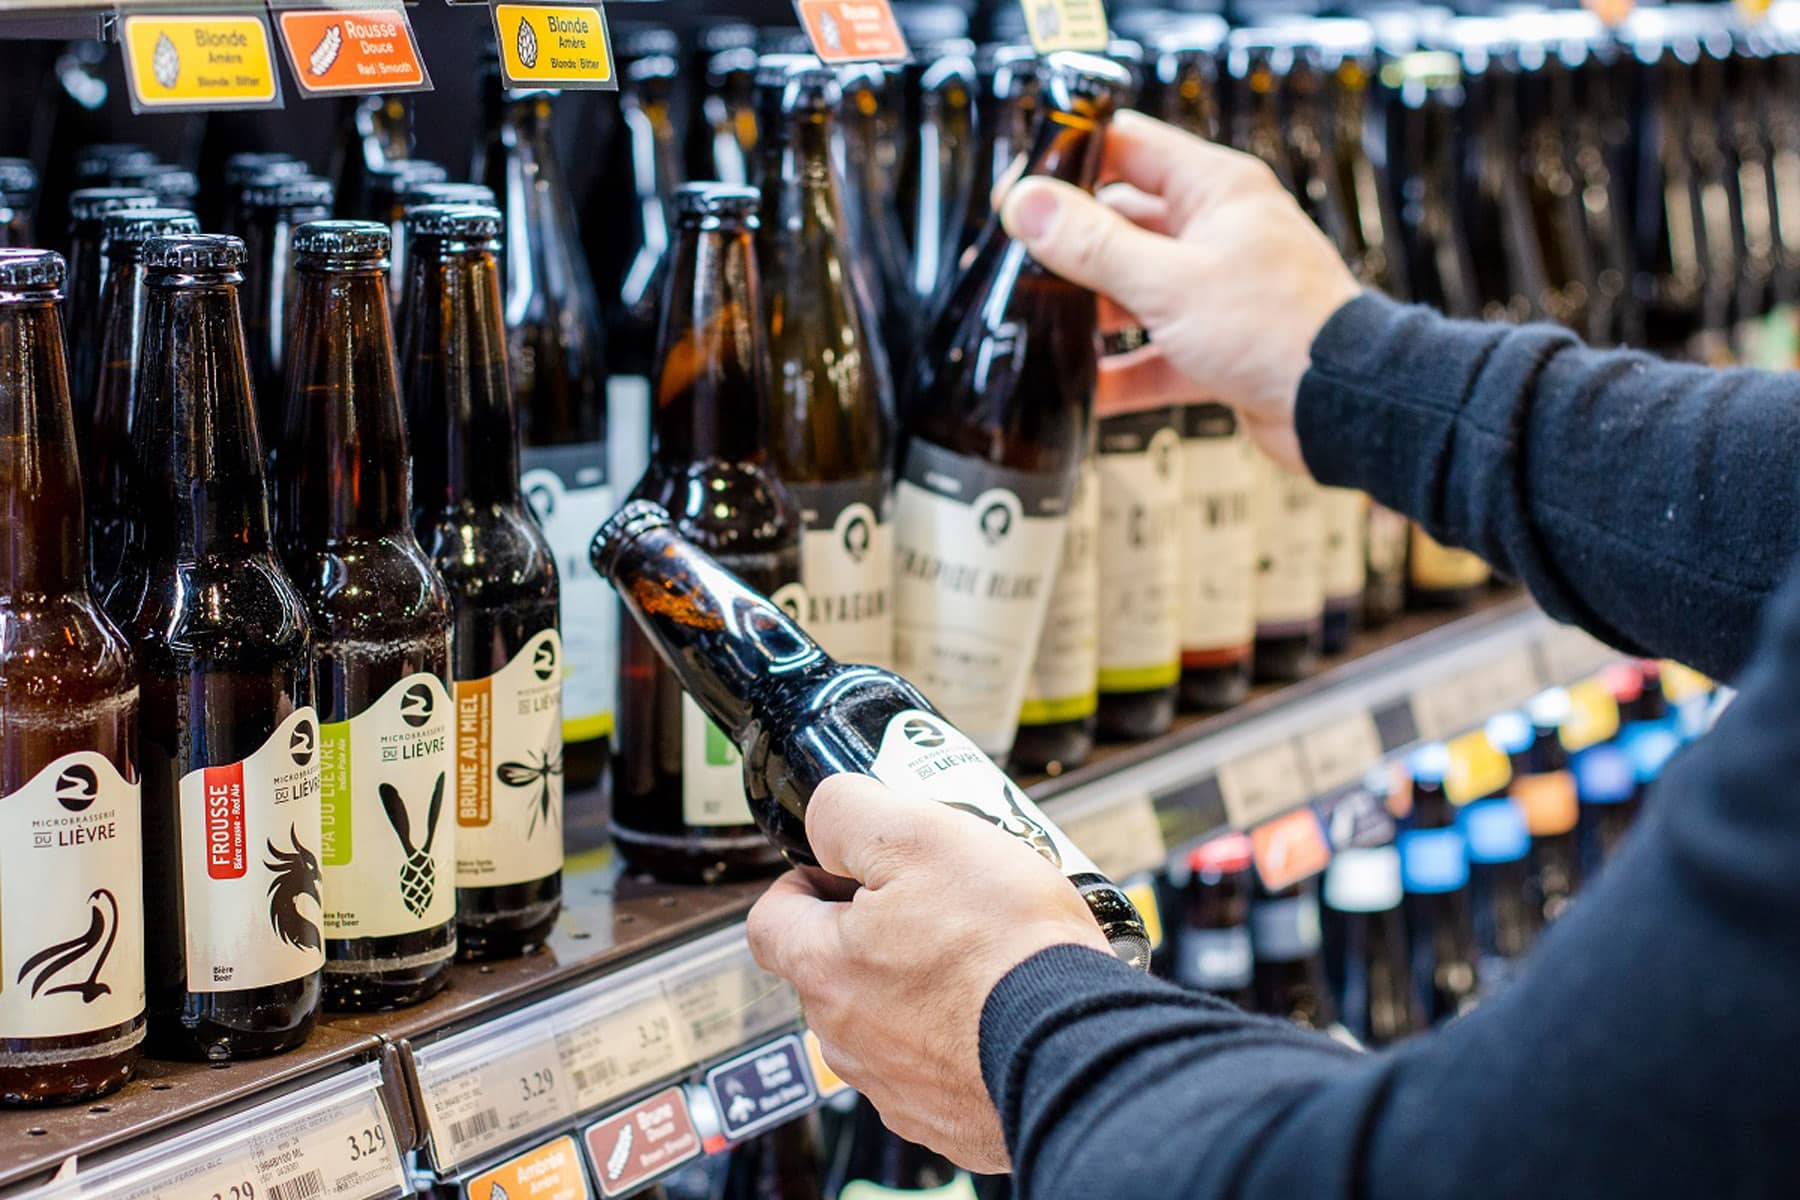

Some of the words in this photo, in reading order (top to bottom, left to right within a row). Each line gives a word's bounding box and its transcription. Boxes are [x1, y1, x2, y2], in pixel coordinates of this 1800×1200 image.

[344, 20, 397, 39] Rousse
[547, 15, 589, 34] Blonde
[194, 28, 248, 47] Blonde
[360, 40, 394, 55] Douce
[356, 63, 376, 76] Red
[550, 58, 577, 69] Blonde
[460, 693, 478, 732] MIEL
[403, 736, 445, 760] LIÈVRE
[460, 736, 478, 759] AU
[231, 783, 241, 797] Ale
[460, 762, 478, 818] BRUNE
[231, 798, 241, 815] Red
[320, 802, 336, 826] DU
[32, 809, 116, 828] MICROBRASSERIE
[209, 784, 230, 865] FROUSSE
[59, 822, 116, 847] LIÈVRE
[233, 820, 242, 847] rousse
[320, 830, 336, 858] IPA
[233, 848, 243, 870] Bière
[213, 965, 234, 974] Bière
[213, 974, 233, 982] Beer
[520, 1068, 554, 1101] 3.29
[347, 1124, 387, 1161] 3.29
